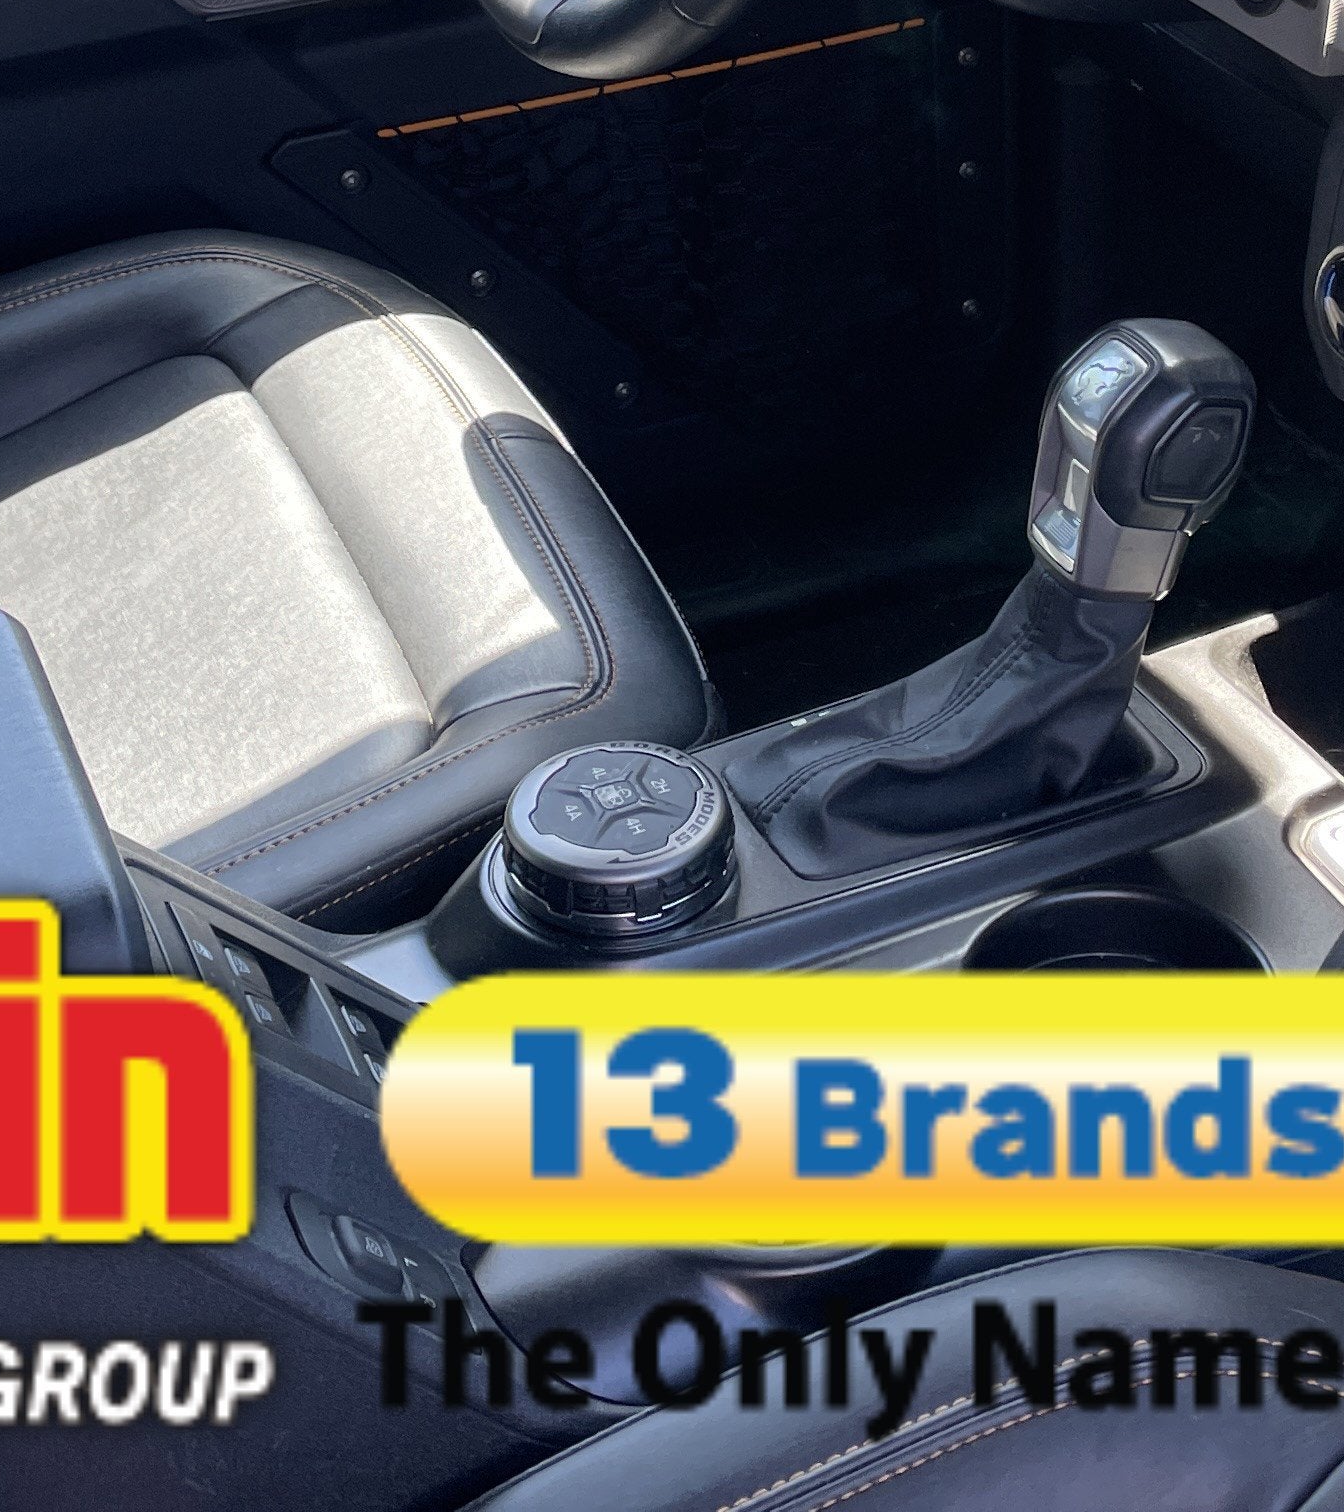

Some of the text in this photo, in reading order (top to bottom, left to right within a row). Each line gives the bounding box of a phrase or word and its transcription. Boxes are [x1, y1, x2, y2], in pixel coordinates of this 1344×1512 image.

[650, 778, 671, 795] 2H
[564, 804, 583, 822] 4A
[674, 791, 715, 846] MODES
[626, 818, 647, 836] 4H
